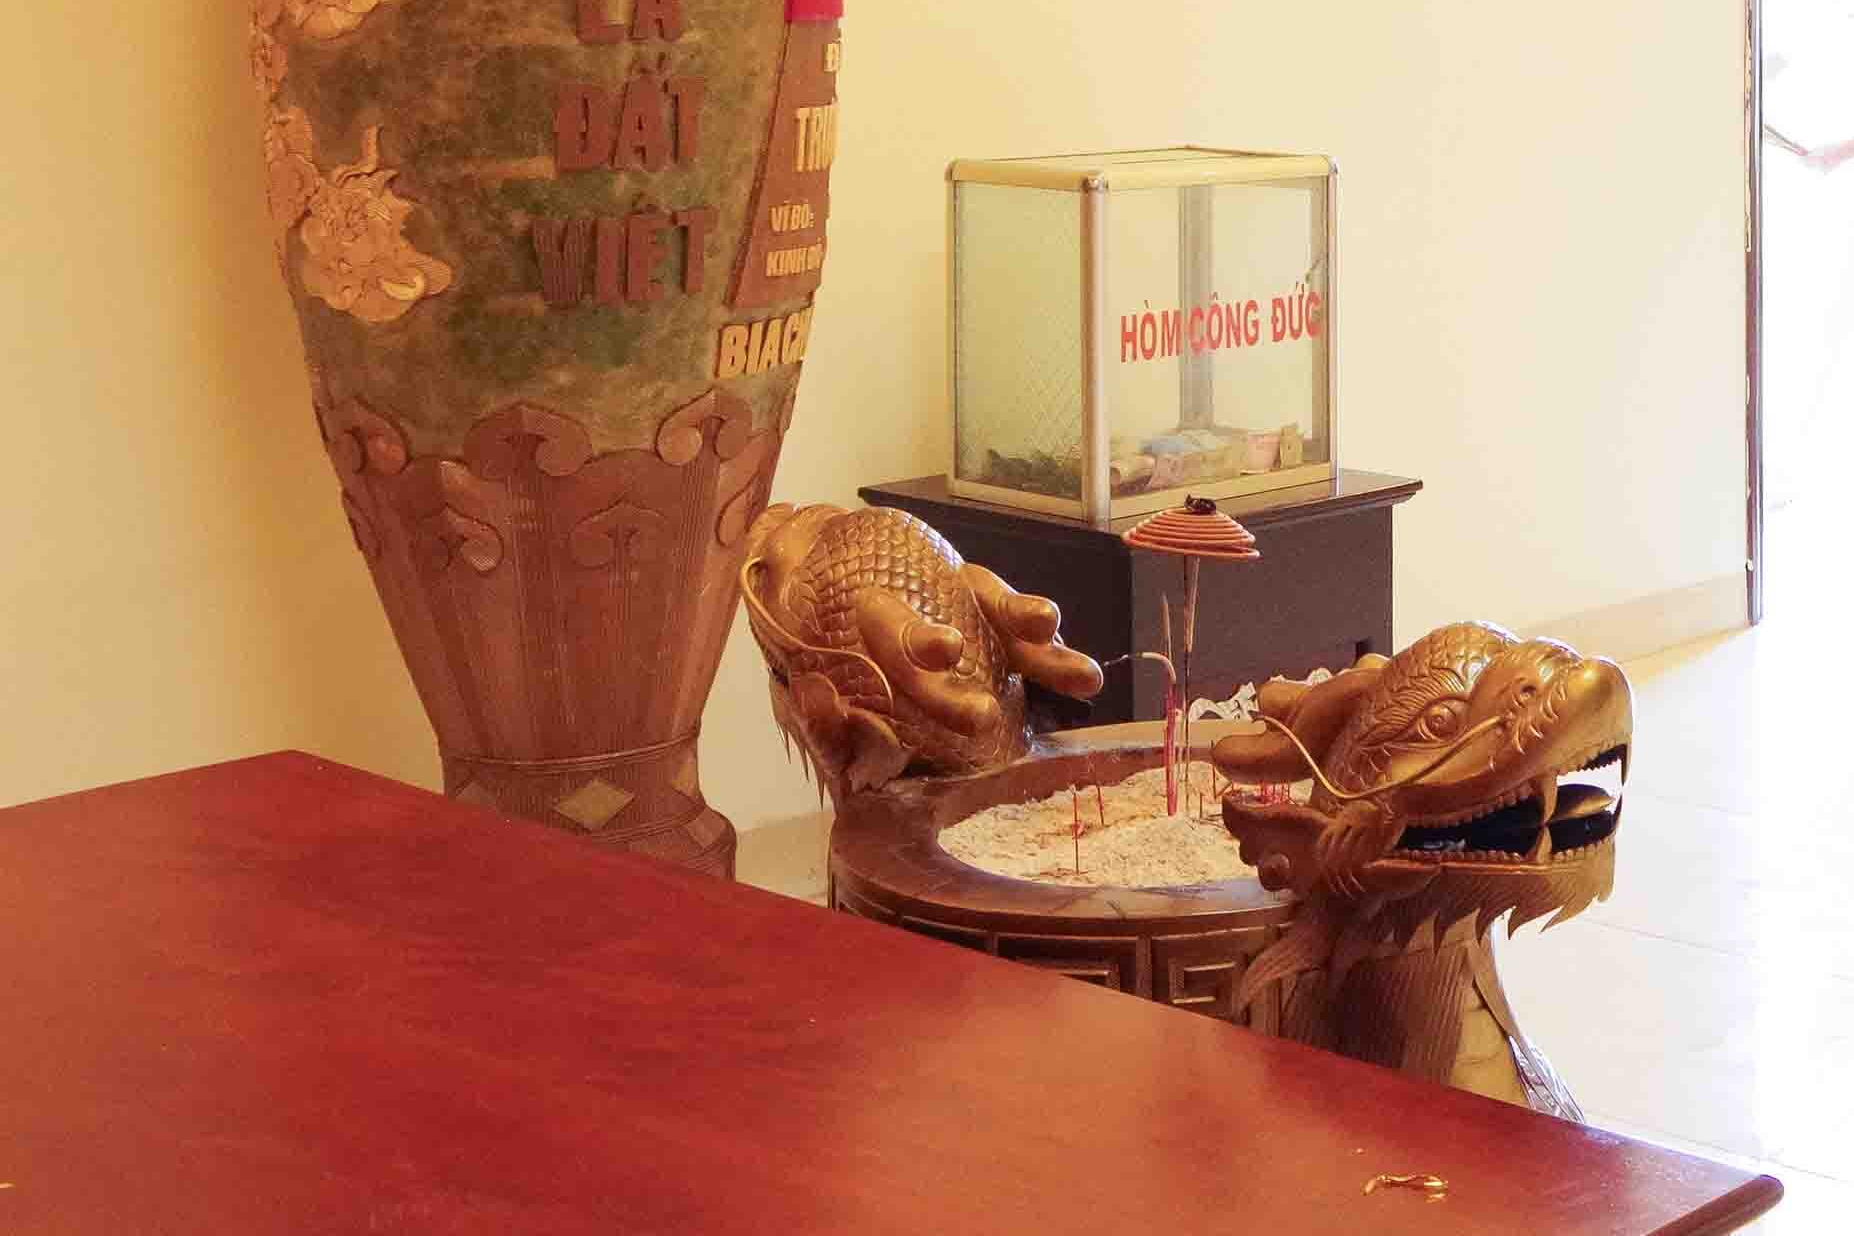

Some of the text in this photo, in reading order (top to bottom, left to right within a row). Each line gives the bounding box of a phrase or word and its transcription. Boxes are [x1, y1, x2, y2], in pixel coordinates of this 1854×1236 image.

[1120, 282, 1321, 363] HÒM CÔNG ĐỨC
